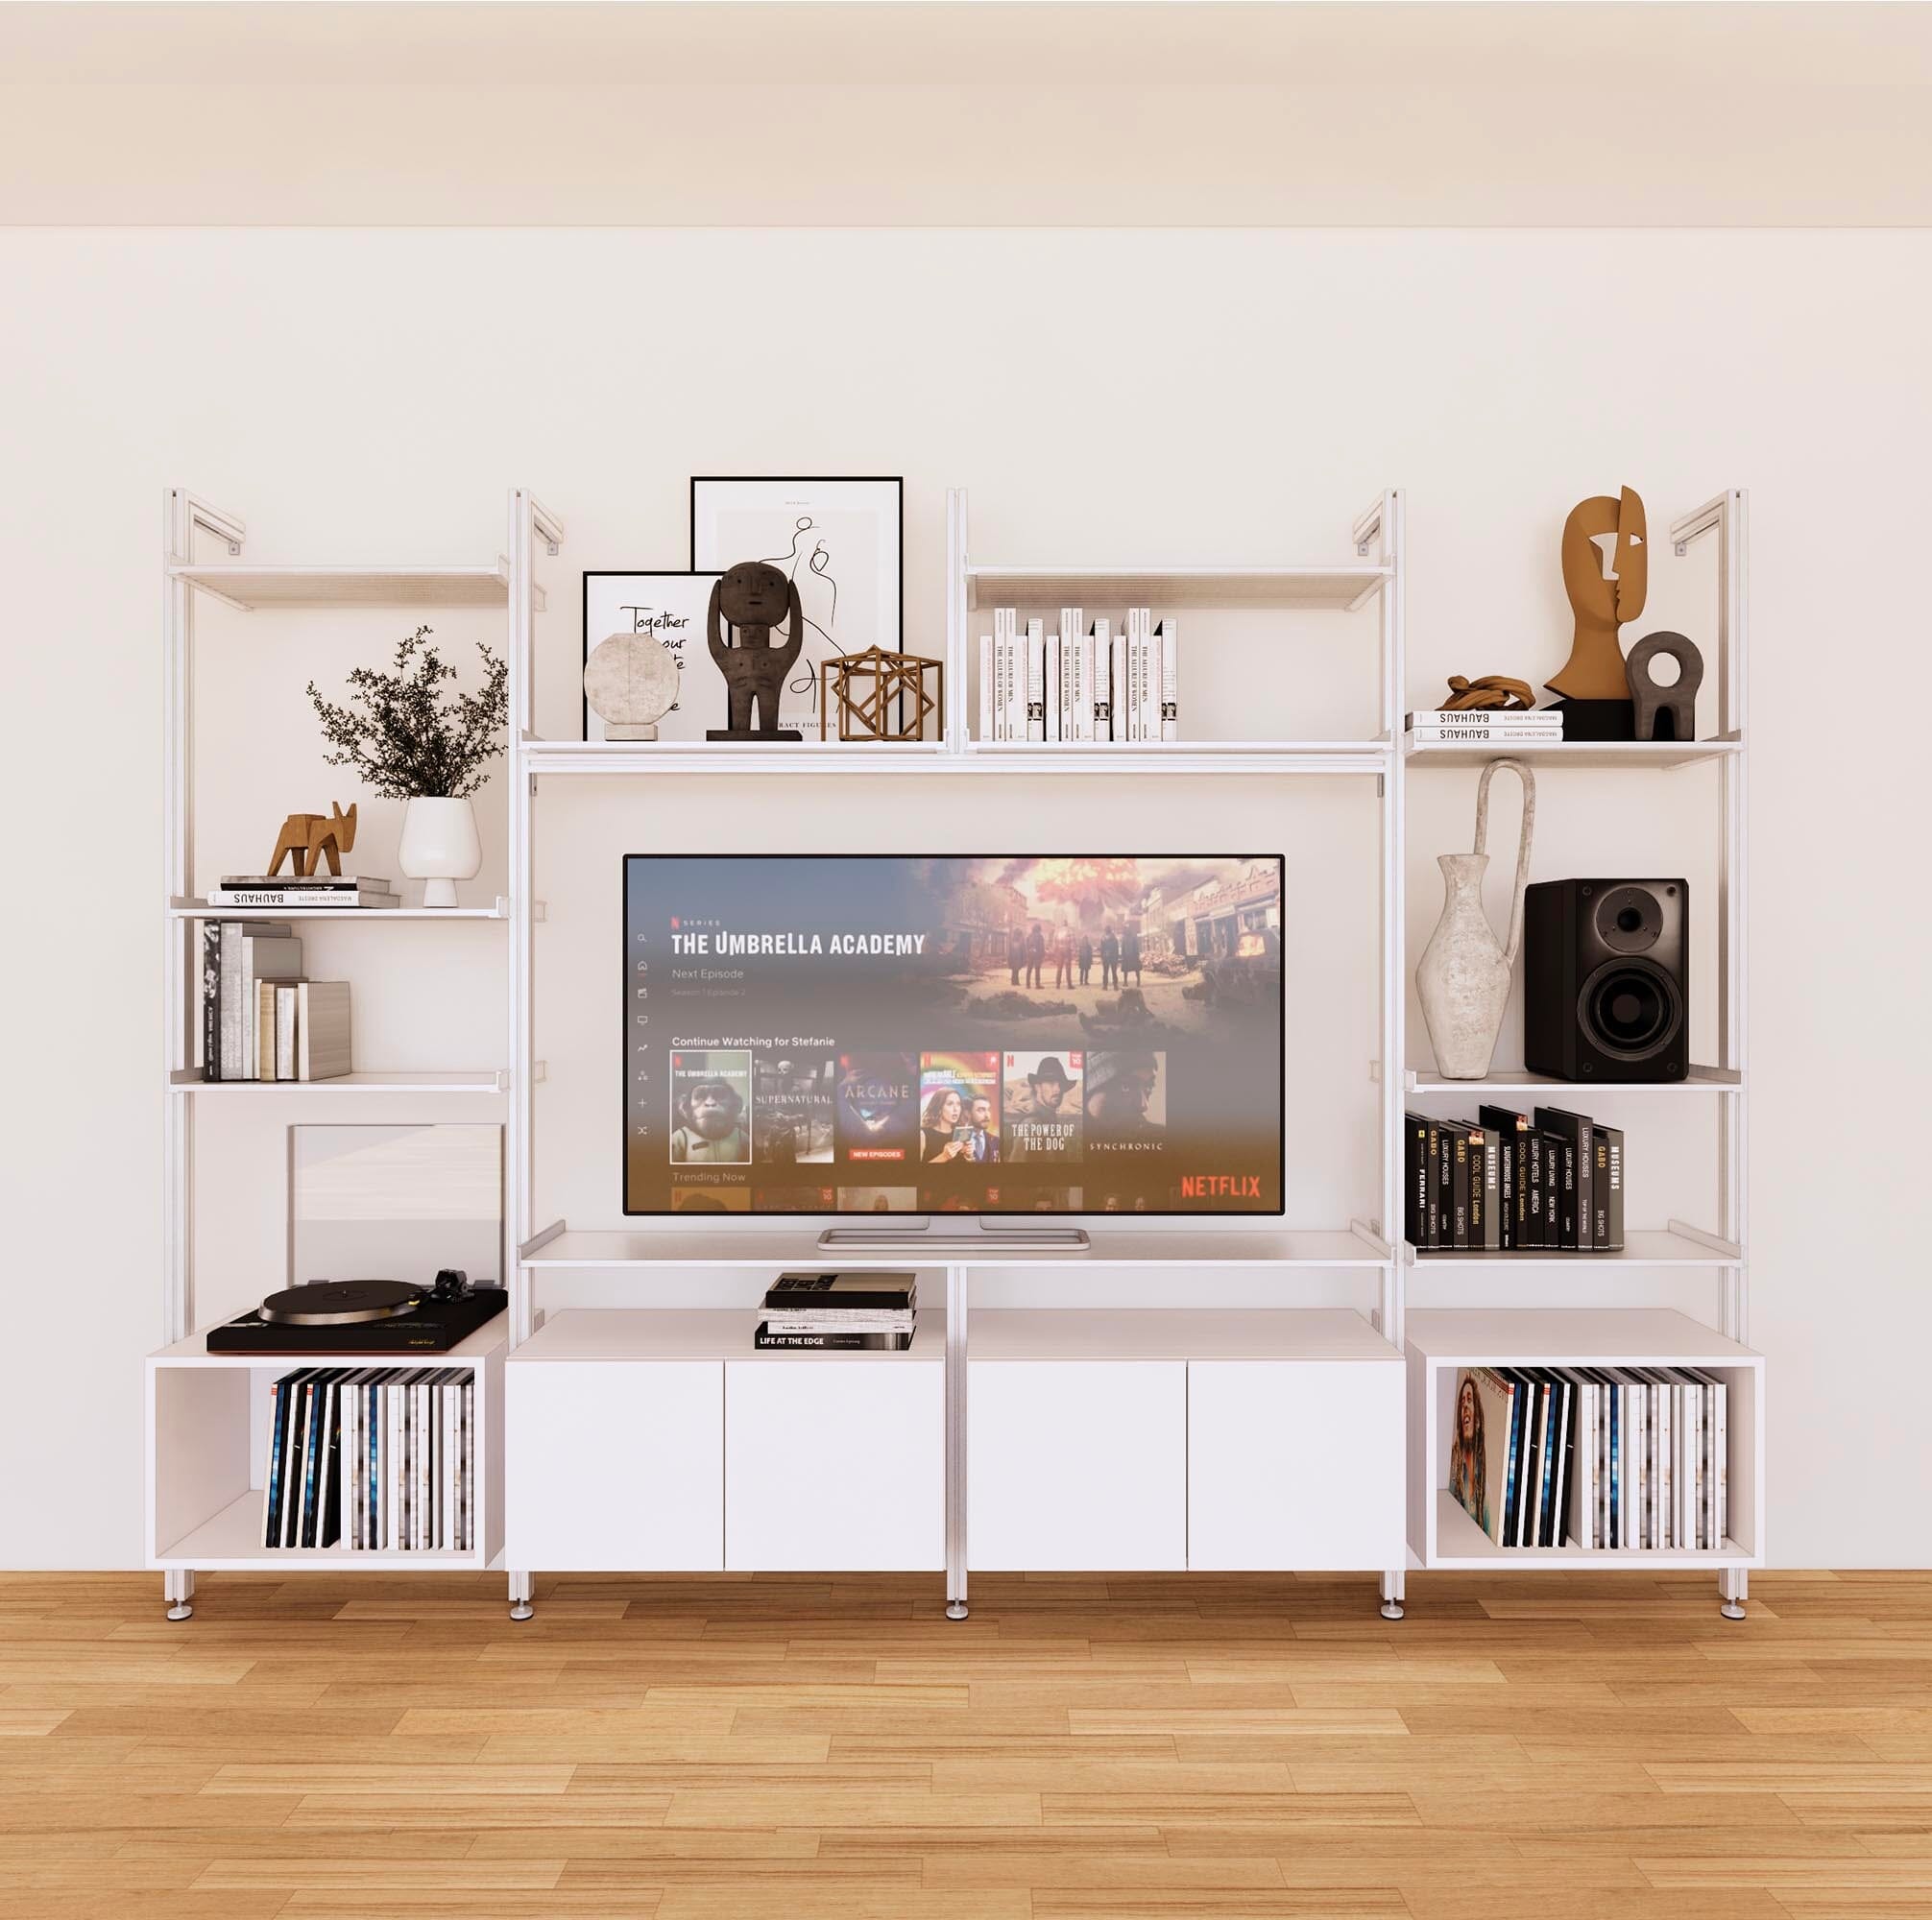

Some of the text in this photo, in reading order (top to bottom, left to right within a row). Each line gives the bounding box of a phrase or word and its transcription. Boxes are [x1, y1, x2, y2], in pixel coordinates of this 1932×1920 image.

[620, 607, 689, 637] Together
[1440, 713, 1489, 722] BAUHAUS
[1440, 730, 1489, 739] BAUHAUS
[233, 894, 284, 903] BAUHAUS
[671, 931, 926, 956] THE UMBRELLA ACADEMY
[672, 968, 744, 981] Next Episode
[672, 1037, 835, 1048] Continue Watching for Stefanie
[845, 1085, 909, 1098] ARCANE
[756, 1094, 833, 1104] SUPERNATURAL
[1012, 1124, 1075, 1137] THE POWER OF
[1024, 1138, 1065, 1151] THE DOG
[1090, 1142, 1163, 1151] SYNCHRONIC
[1487, 1146, 1496, 1189] MUSEUMS
[673, 1171, 746, 1183] Trending Now
[1181, 1175, 1260, 1198] NETFLIX
